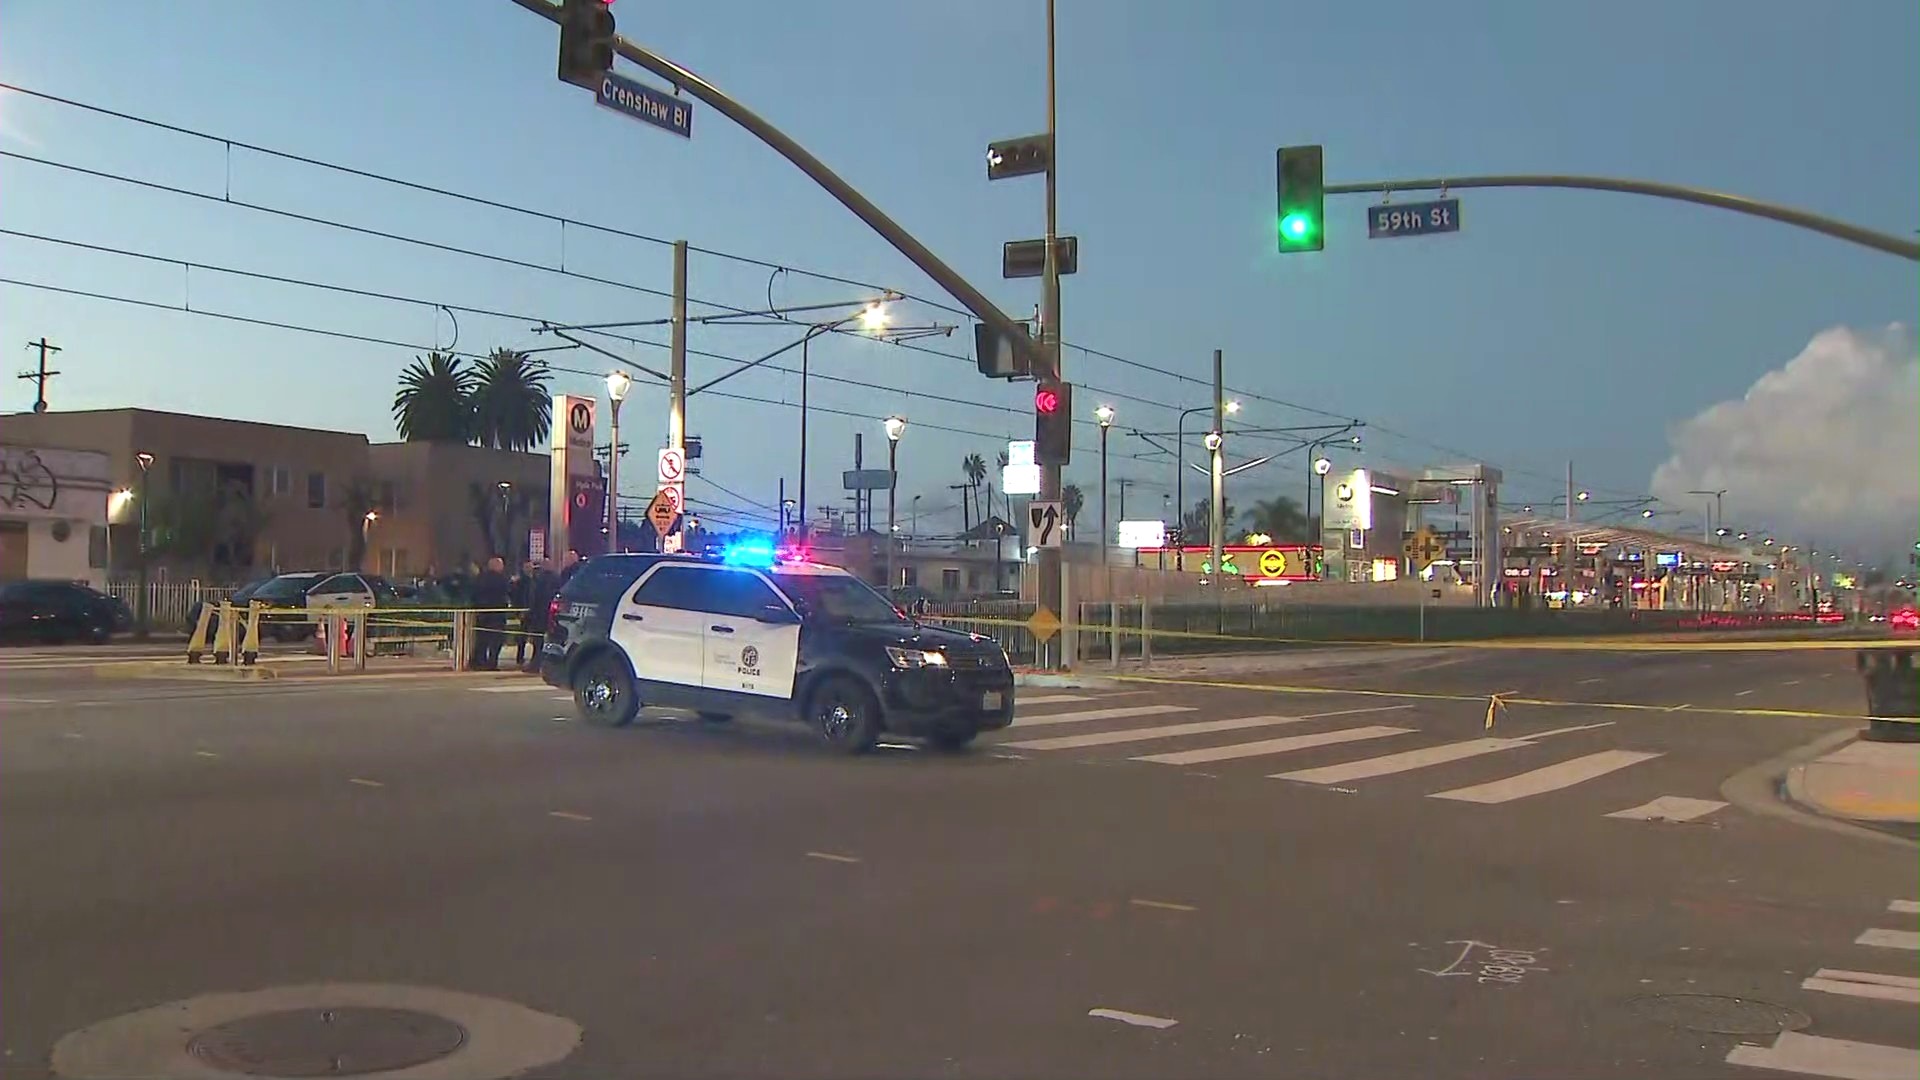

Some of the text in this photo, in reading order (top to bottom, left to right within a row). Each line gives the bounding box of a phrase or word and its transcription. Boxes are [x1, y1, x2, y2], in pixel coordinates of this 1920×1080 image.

[602, 78, 687, 128] Crenshaw Bl
[1378, 207, 1450, 231] 59th St
[573, 407, 588, 430] M
[737, 666, 760, 677] POLICE
